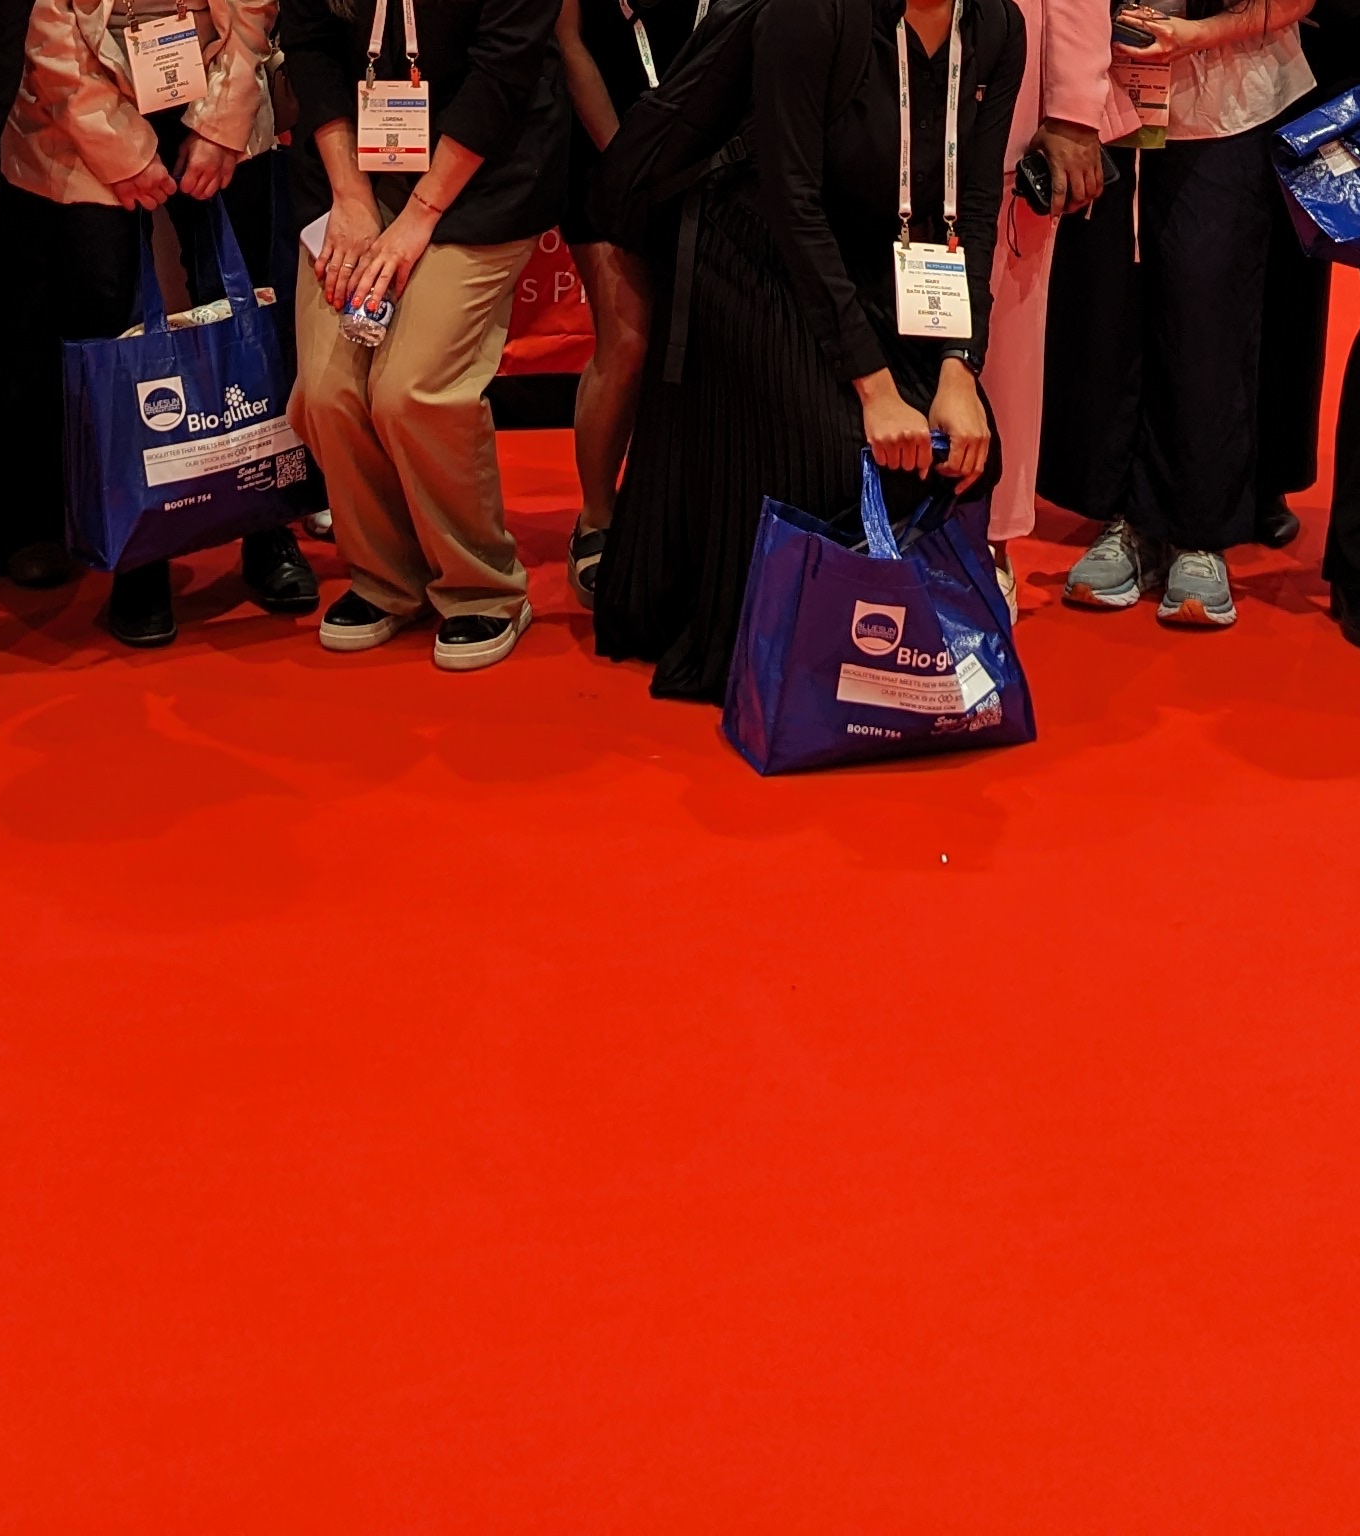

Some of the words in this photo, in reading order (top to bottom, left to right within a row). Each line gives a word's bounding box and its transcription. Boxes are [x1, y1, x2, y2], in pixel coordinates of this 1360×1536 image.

[554, 271, 586, 304] P
[146, 448, 181, 462] BIOGLITTER
[181, 445, 197, 455] THAT
[197, 442, 218, 452] MEETS
[231, 426, 272, 446] MICROPLASTICS
[271, 419, 291, 433] REGUL
[185, 458, 199, 468] OUR
[199, 455, 221, 466] STOCK
[237, 465, 257, 479] Scan
[257, 460, 272, 472] this
[164, 497, 196, 512] BOOTH
[197, 492, 212, 504] 754
[896, 646, 953, 672] Bio-gl
[843, 668, 881, 681] BIOGLITTER
[899, 678, 921, 687] MEETS
[922, 680, 937, 689] NEW
[938, 680, 960, 689] MICRO
[957, 659, 977, 679] LATION
[881, 688, 897, 697] OUR
[897, 690, 922, 701] STOCK
[846, 723, 883, 737] BOOTH
